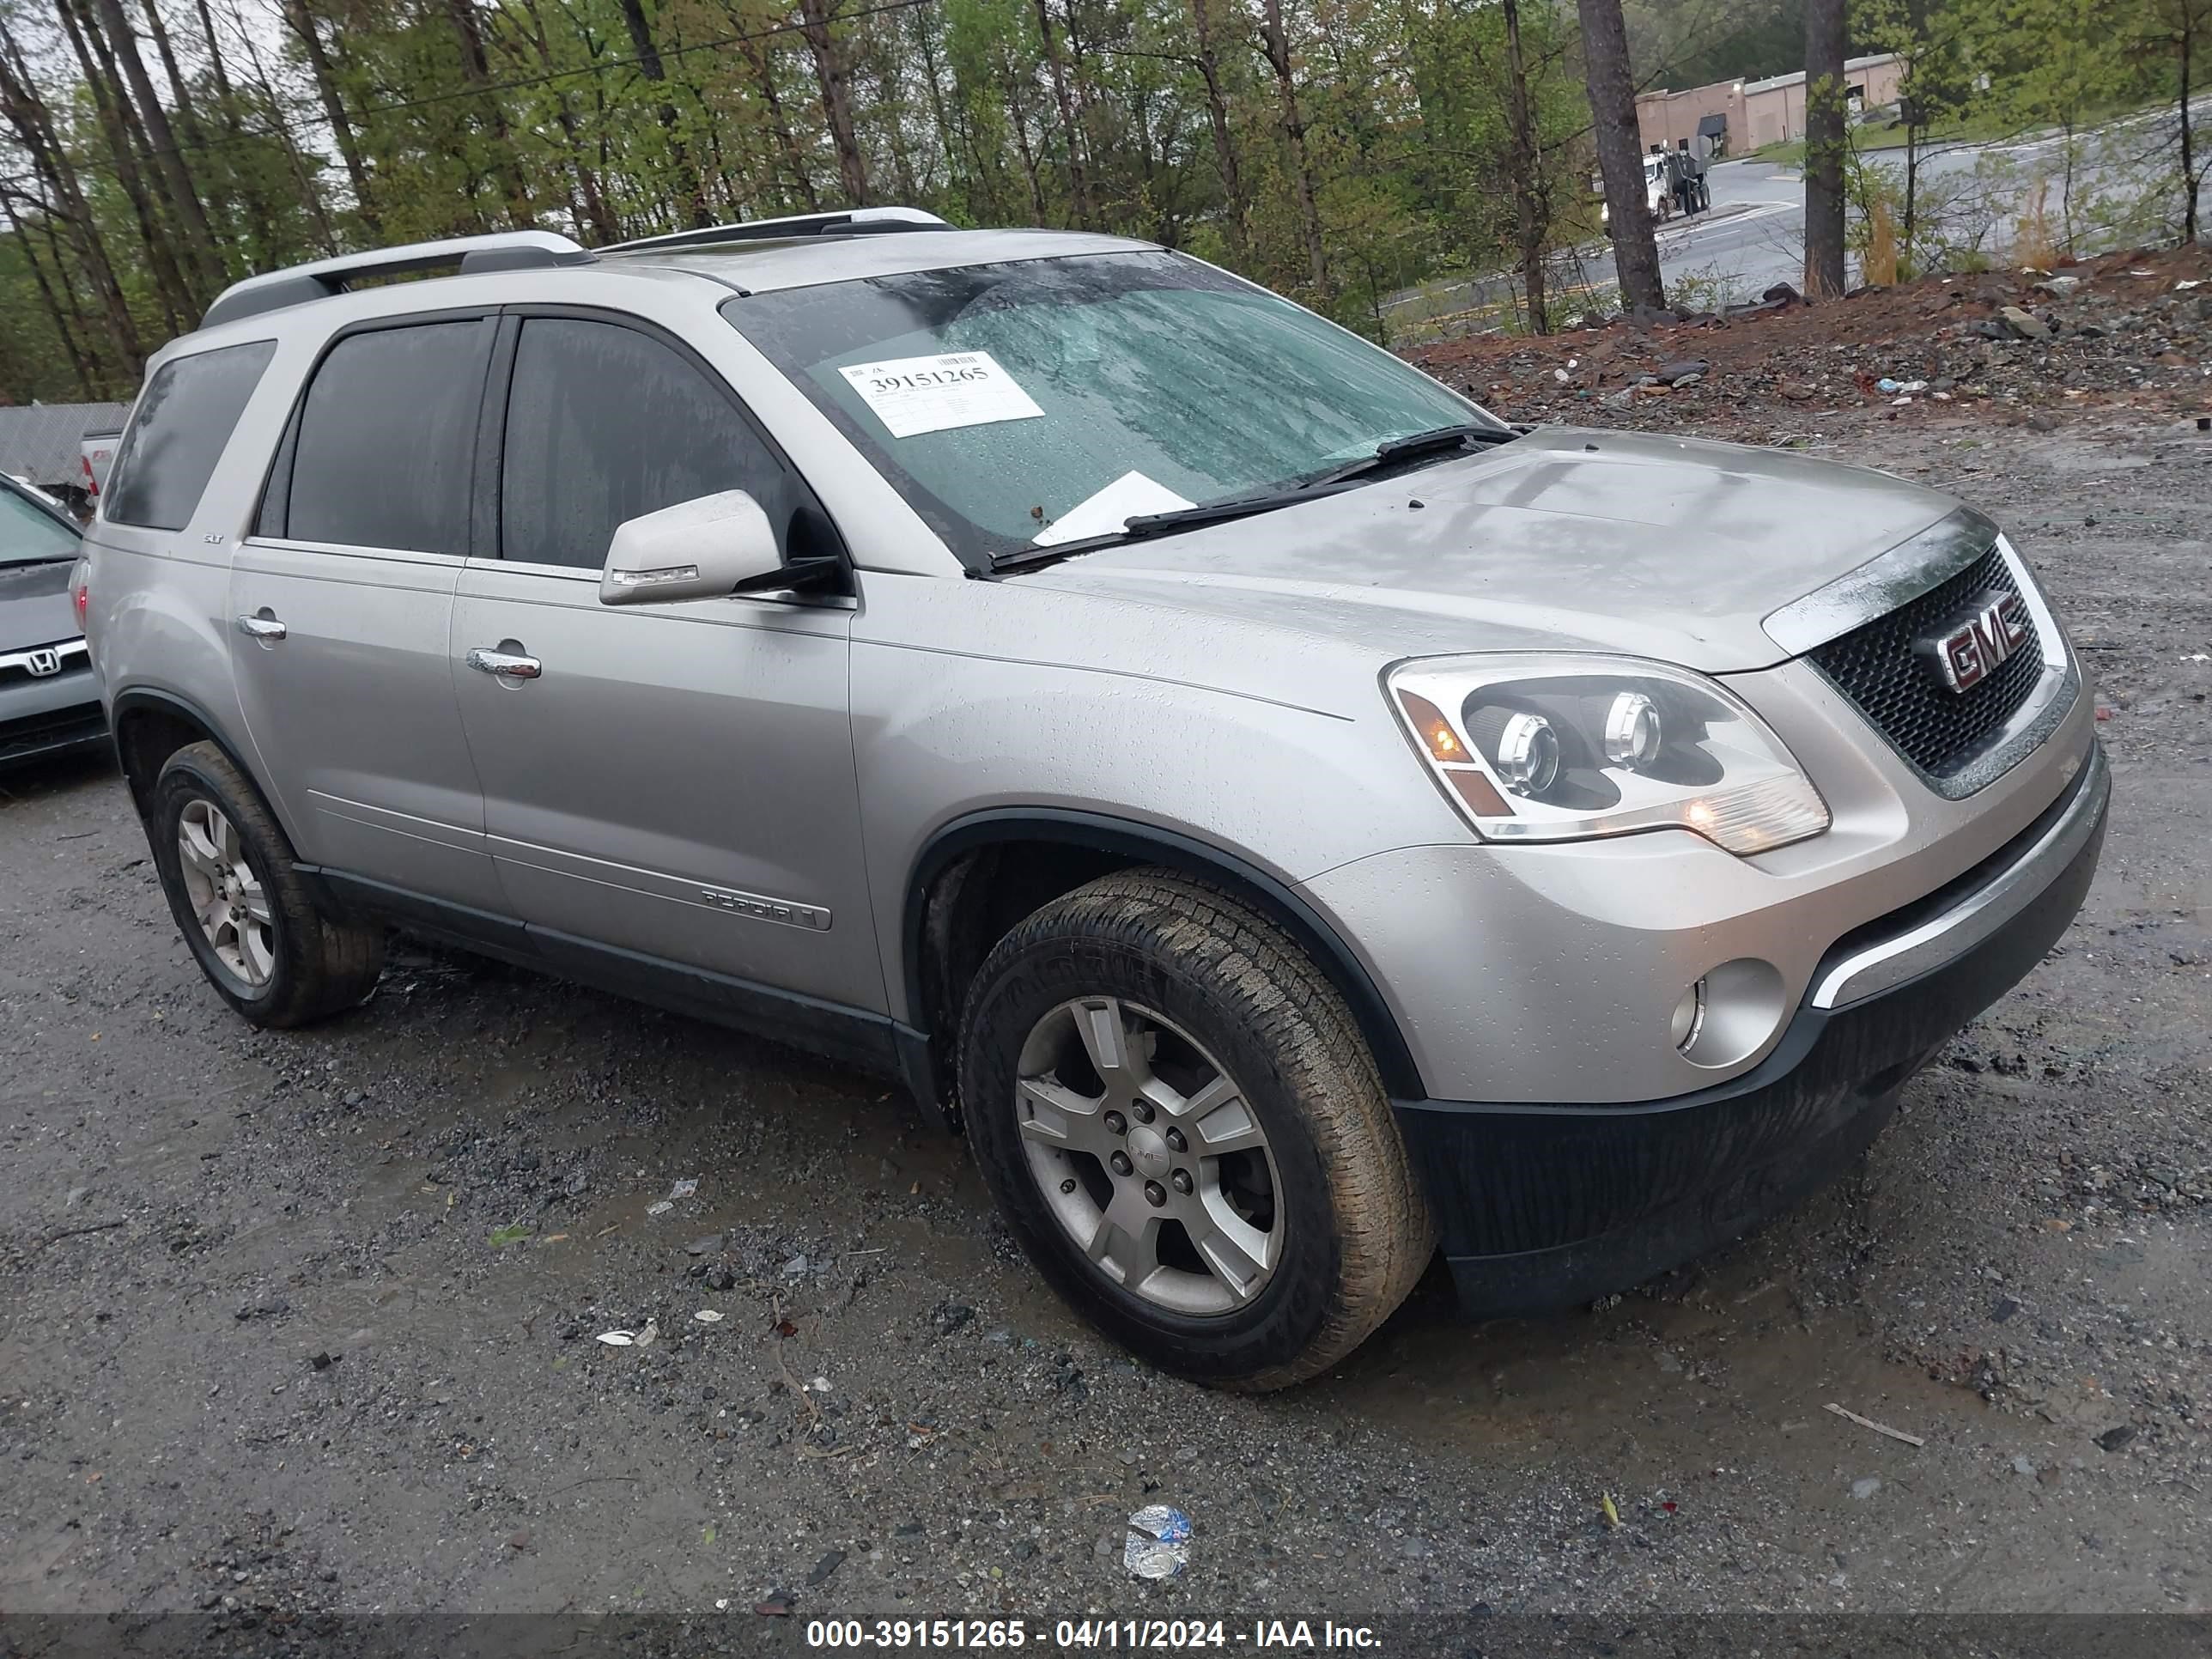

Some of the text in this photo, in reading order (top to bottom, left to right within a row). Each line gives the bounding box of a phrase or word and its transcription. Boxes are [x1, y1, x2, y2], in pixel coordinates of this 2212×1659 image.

[869, 367, 988, 393] 39151265
[204, 534, 224, 544] SLT
[1937, 591, 2027, 694] GMC
